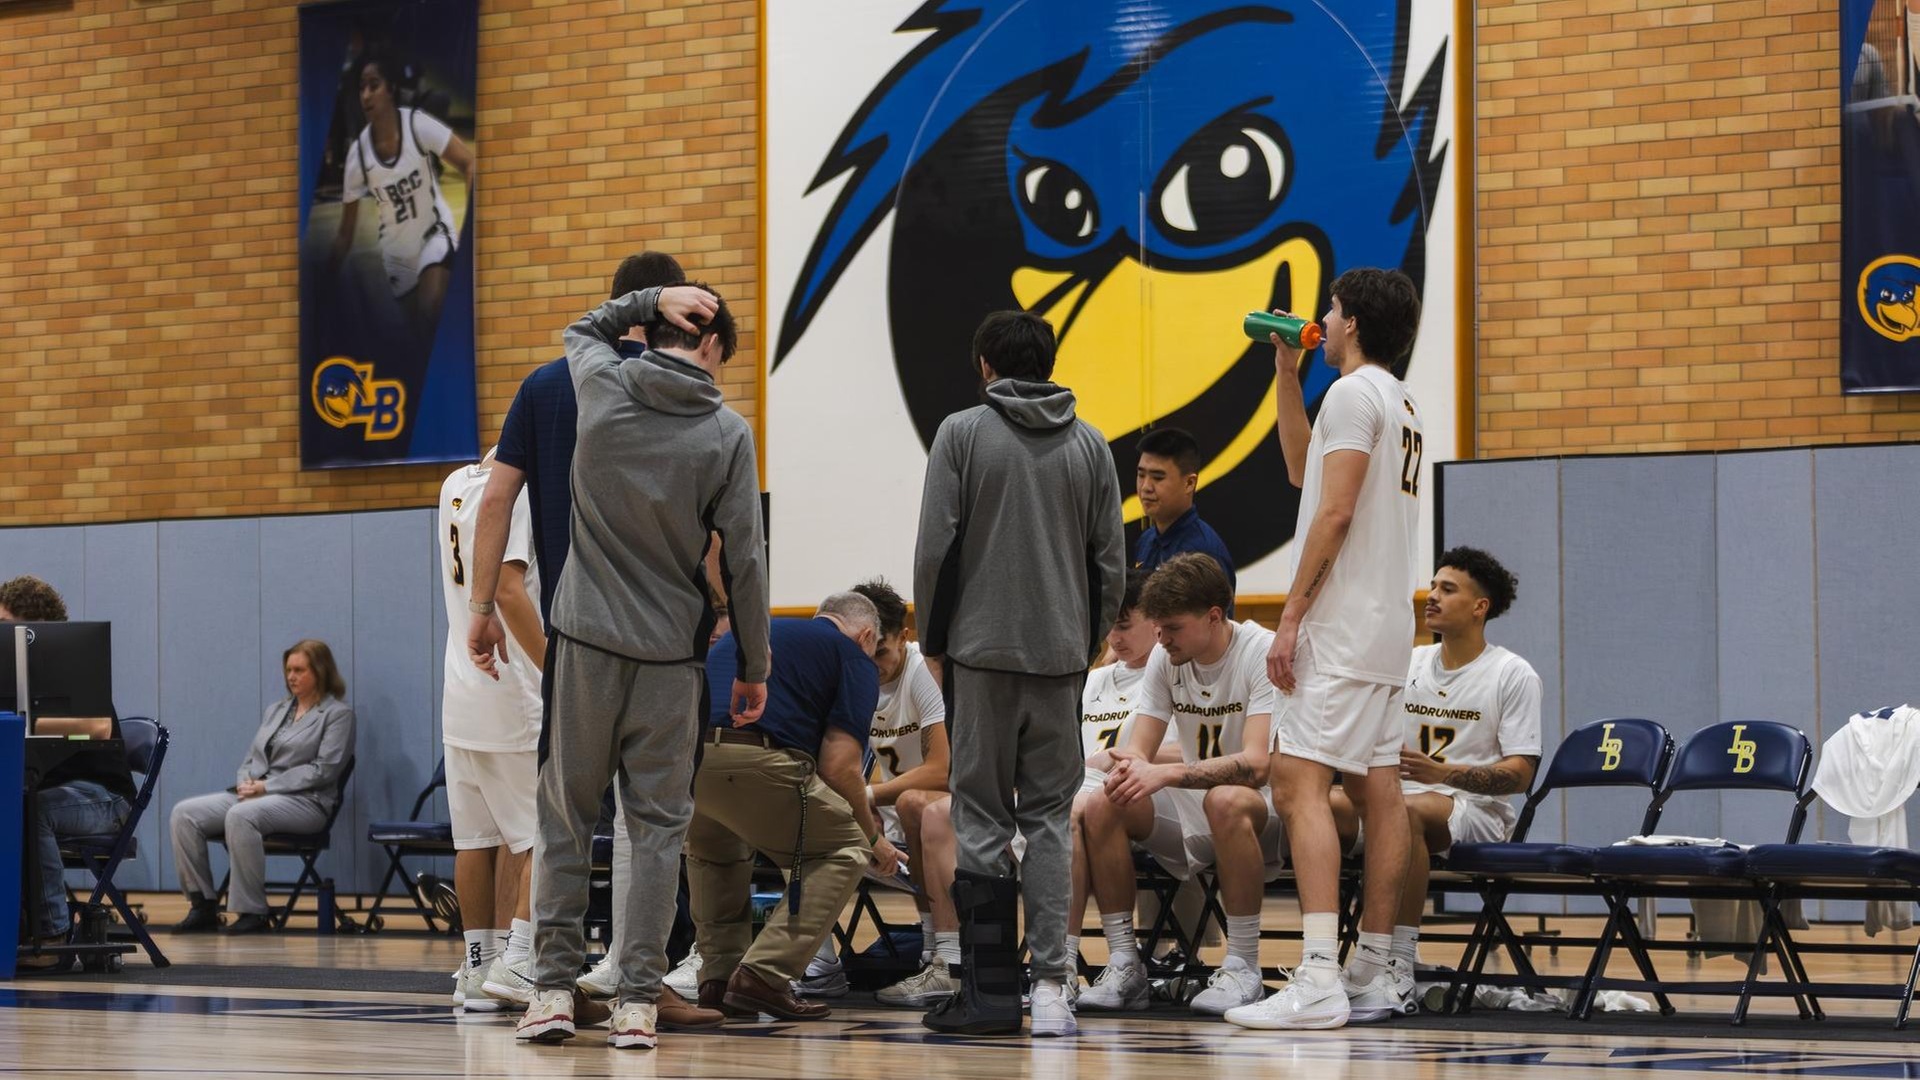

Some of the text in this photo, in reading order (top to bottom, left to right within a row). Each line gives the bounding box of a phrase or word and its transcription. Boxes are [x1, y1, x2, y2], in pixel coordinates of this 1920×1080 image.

[395, 195, 417, 224] 21
[1400, 424, 1422, 498] 22
[449, 522, 465, 587] 3
[1097, 722, 1123, 750] 7
[1419, 723, 1456, 764] 12
[877, 745, 904, 778] 2
